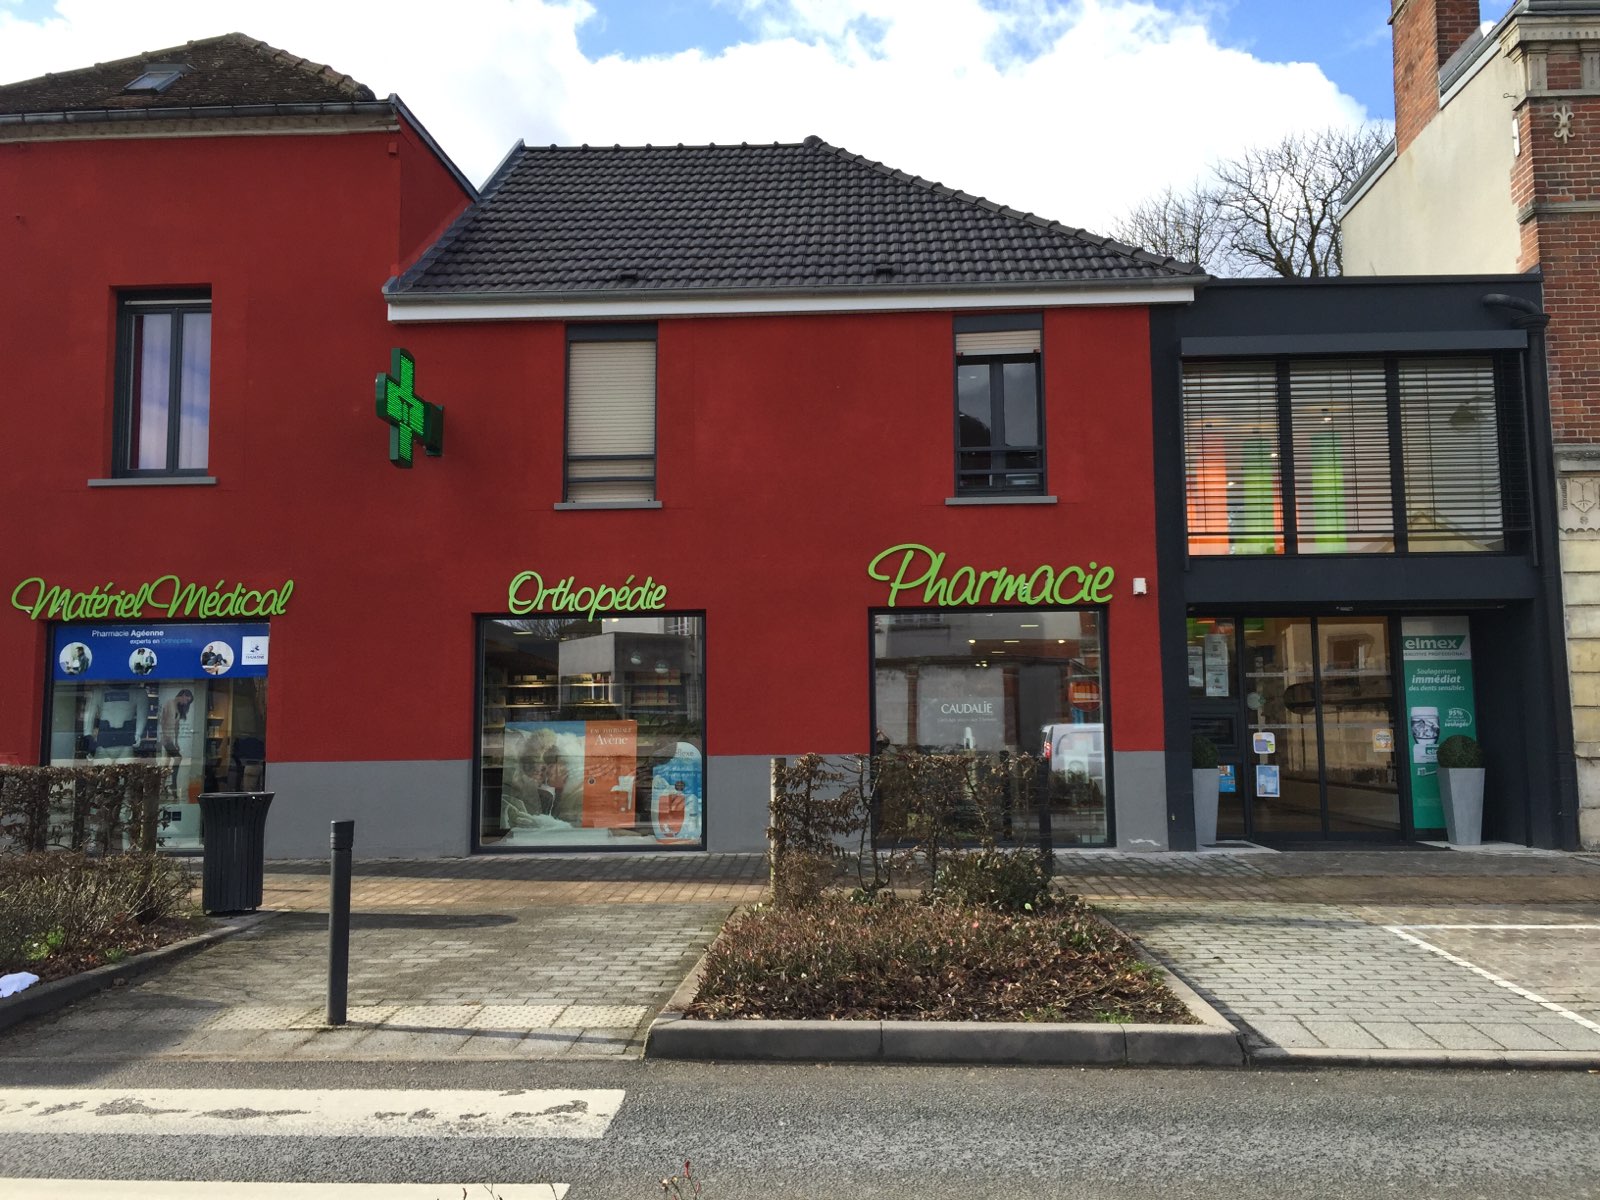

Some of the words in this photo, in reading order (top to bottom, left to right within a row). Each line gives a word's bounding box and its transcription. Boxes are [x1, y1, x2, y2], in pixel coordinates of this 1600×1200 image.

[868, 543, 1114, 606] Pharmacie
[12, 577, 148, 621] Matériel
[149, 575, 294, 618] Médical
[509, 571, 667, 622] Orthopédie
[1404, 638, 1458, 649] elmex
[1416, 668, 1457, 676] Soulagement
[1411, 675, 1462, 684] immédiat
[594, 734, 629, 745] Avène
